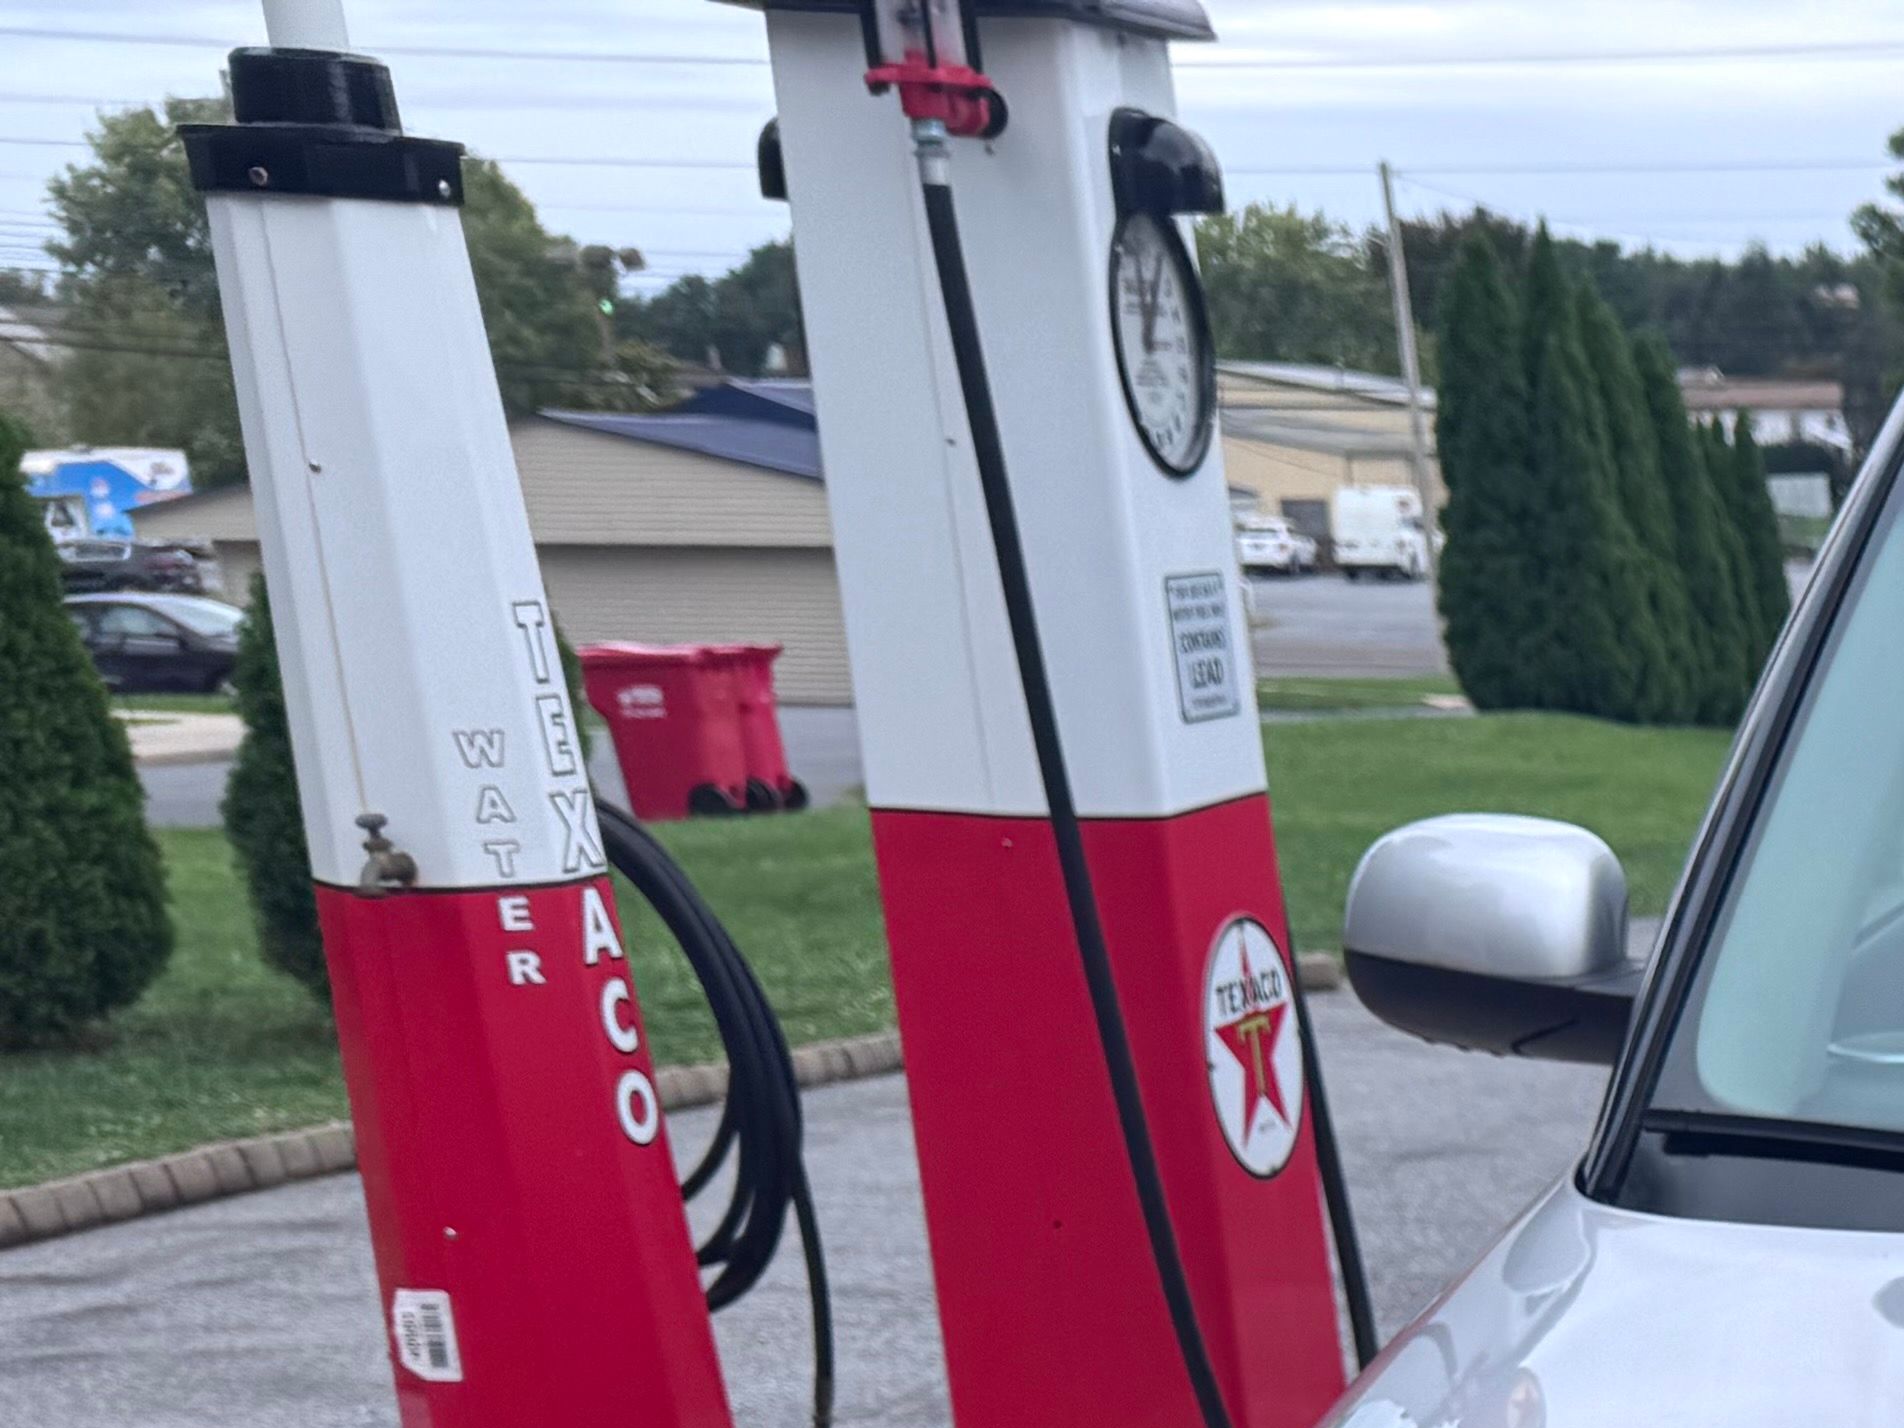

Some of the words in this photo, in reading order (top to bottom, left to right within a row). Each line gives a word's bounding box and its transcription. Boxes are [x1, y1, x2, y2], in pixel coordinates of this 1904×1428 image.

[1190, 658, 1224, 689] LEAD
[453, 730, 547, 985] WATER
[512, 601, 659, 1146] TEXACO
[1216, 970, 1282, 1015] TEXACO
